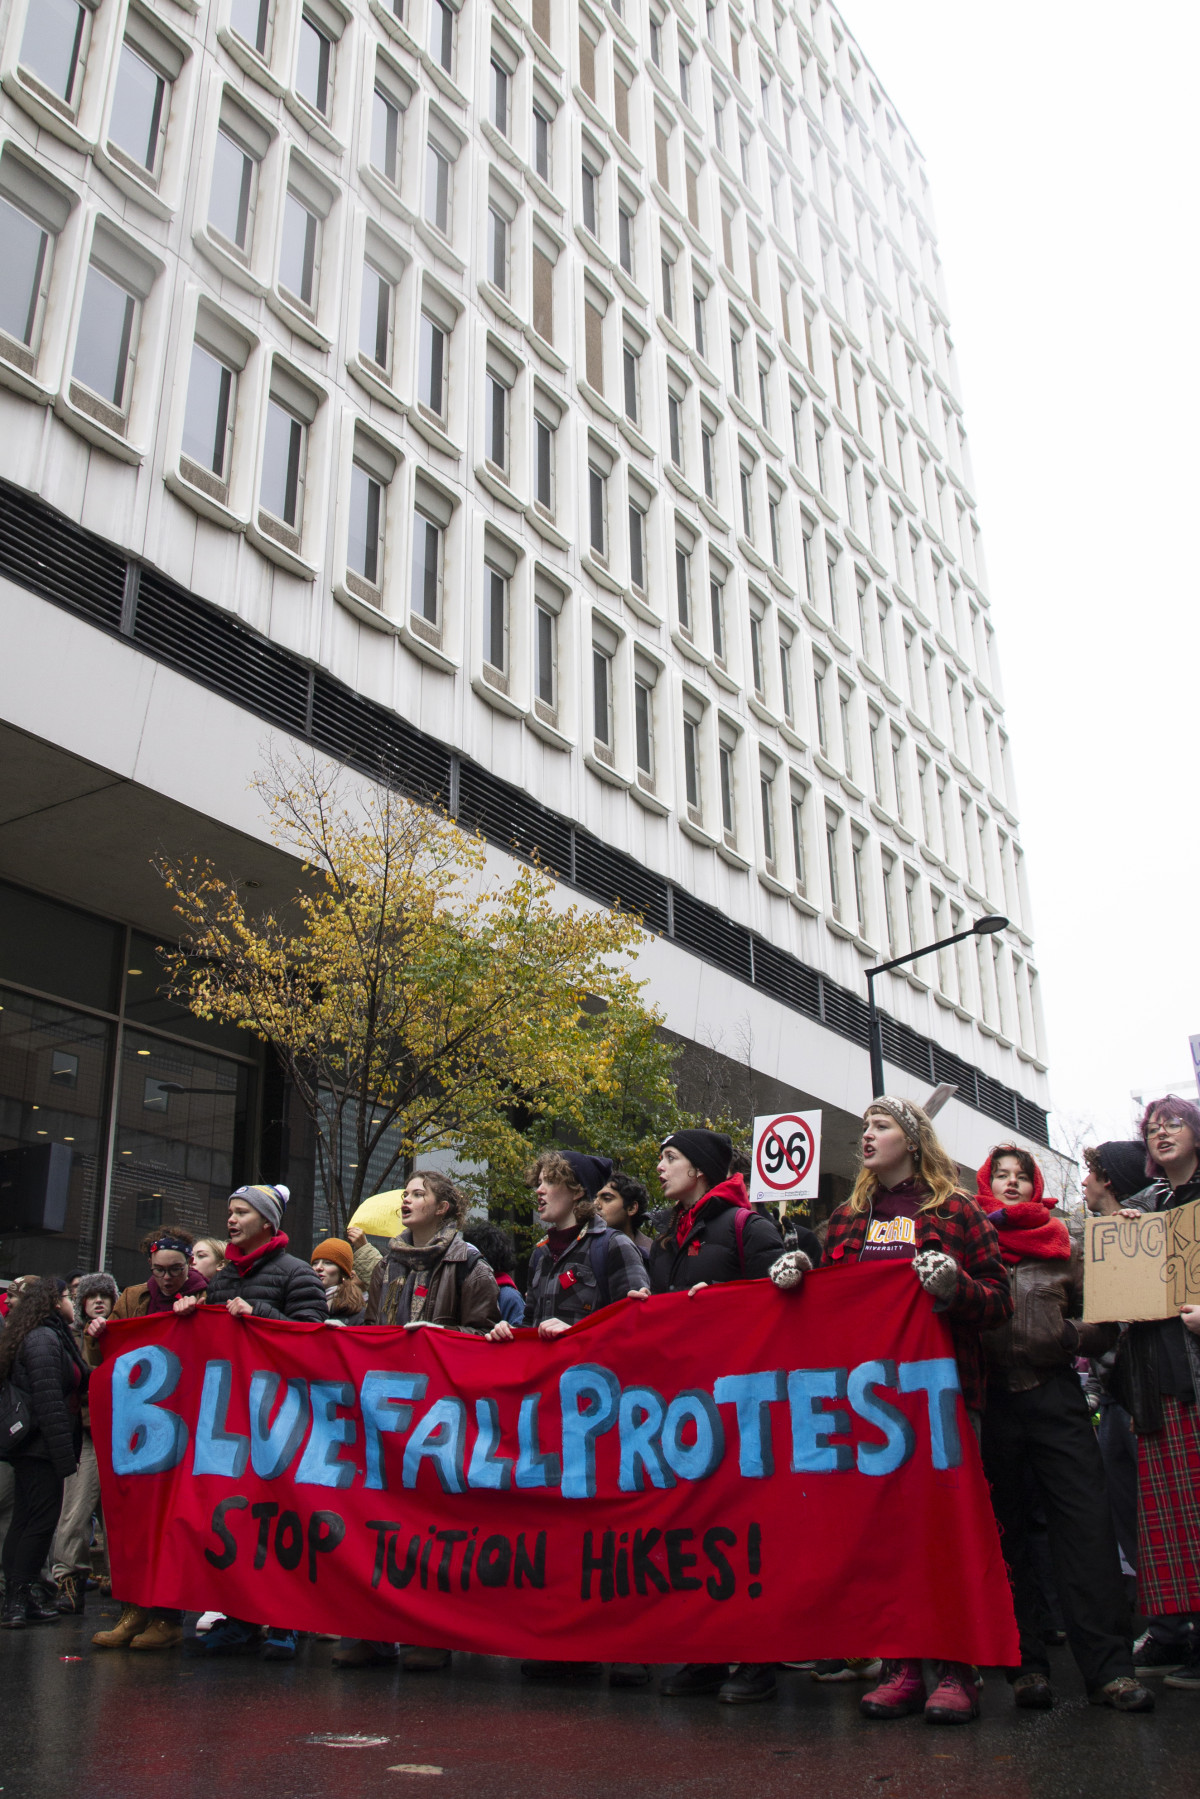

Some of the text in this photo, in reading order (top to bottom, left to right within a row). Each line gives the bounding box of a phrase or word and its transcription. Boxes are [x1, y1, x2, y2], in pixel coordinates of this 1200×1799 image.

[764, 1131, 806, 1174] 96
[1092, 1207, 1191, 1263] FUCK
[204, 1495, 346, 1584] STOP
